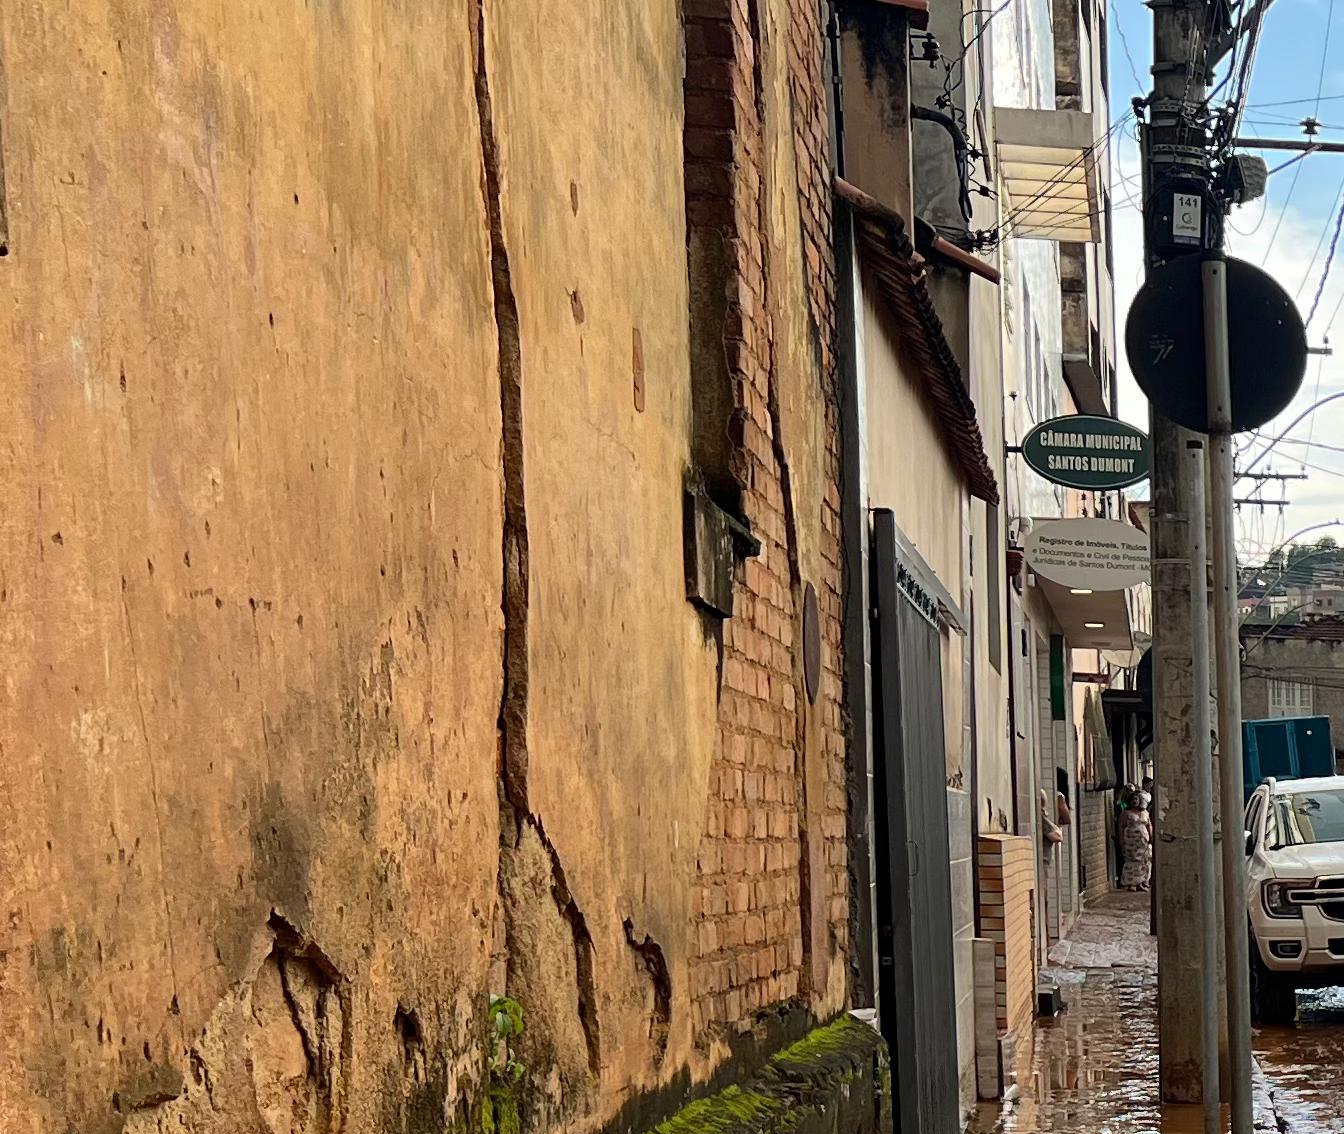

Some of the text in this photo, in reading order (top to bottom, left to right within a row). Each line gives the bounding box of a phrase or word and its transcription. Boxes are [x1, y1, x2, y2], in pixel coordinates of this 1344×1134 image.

[1179, 197, 1198, 208] 141
[1040, 430, 1143, 451] CÂMARA MUNICIPAL
[1048, 454, 1135, 474] SANTOS DUMONT
[1039, 536, 1073, 546] Registro
[1039, 548, 1085, 558] Documentos
[1079, 560, 1105, 569] Santos
[1106, 562, 1136, 571] Dumont
